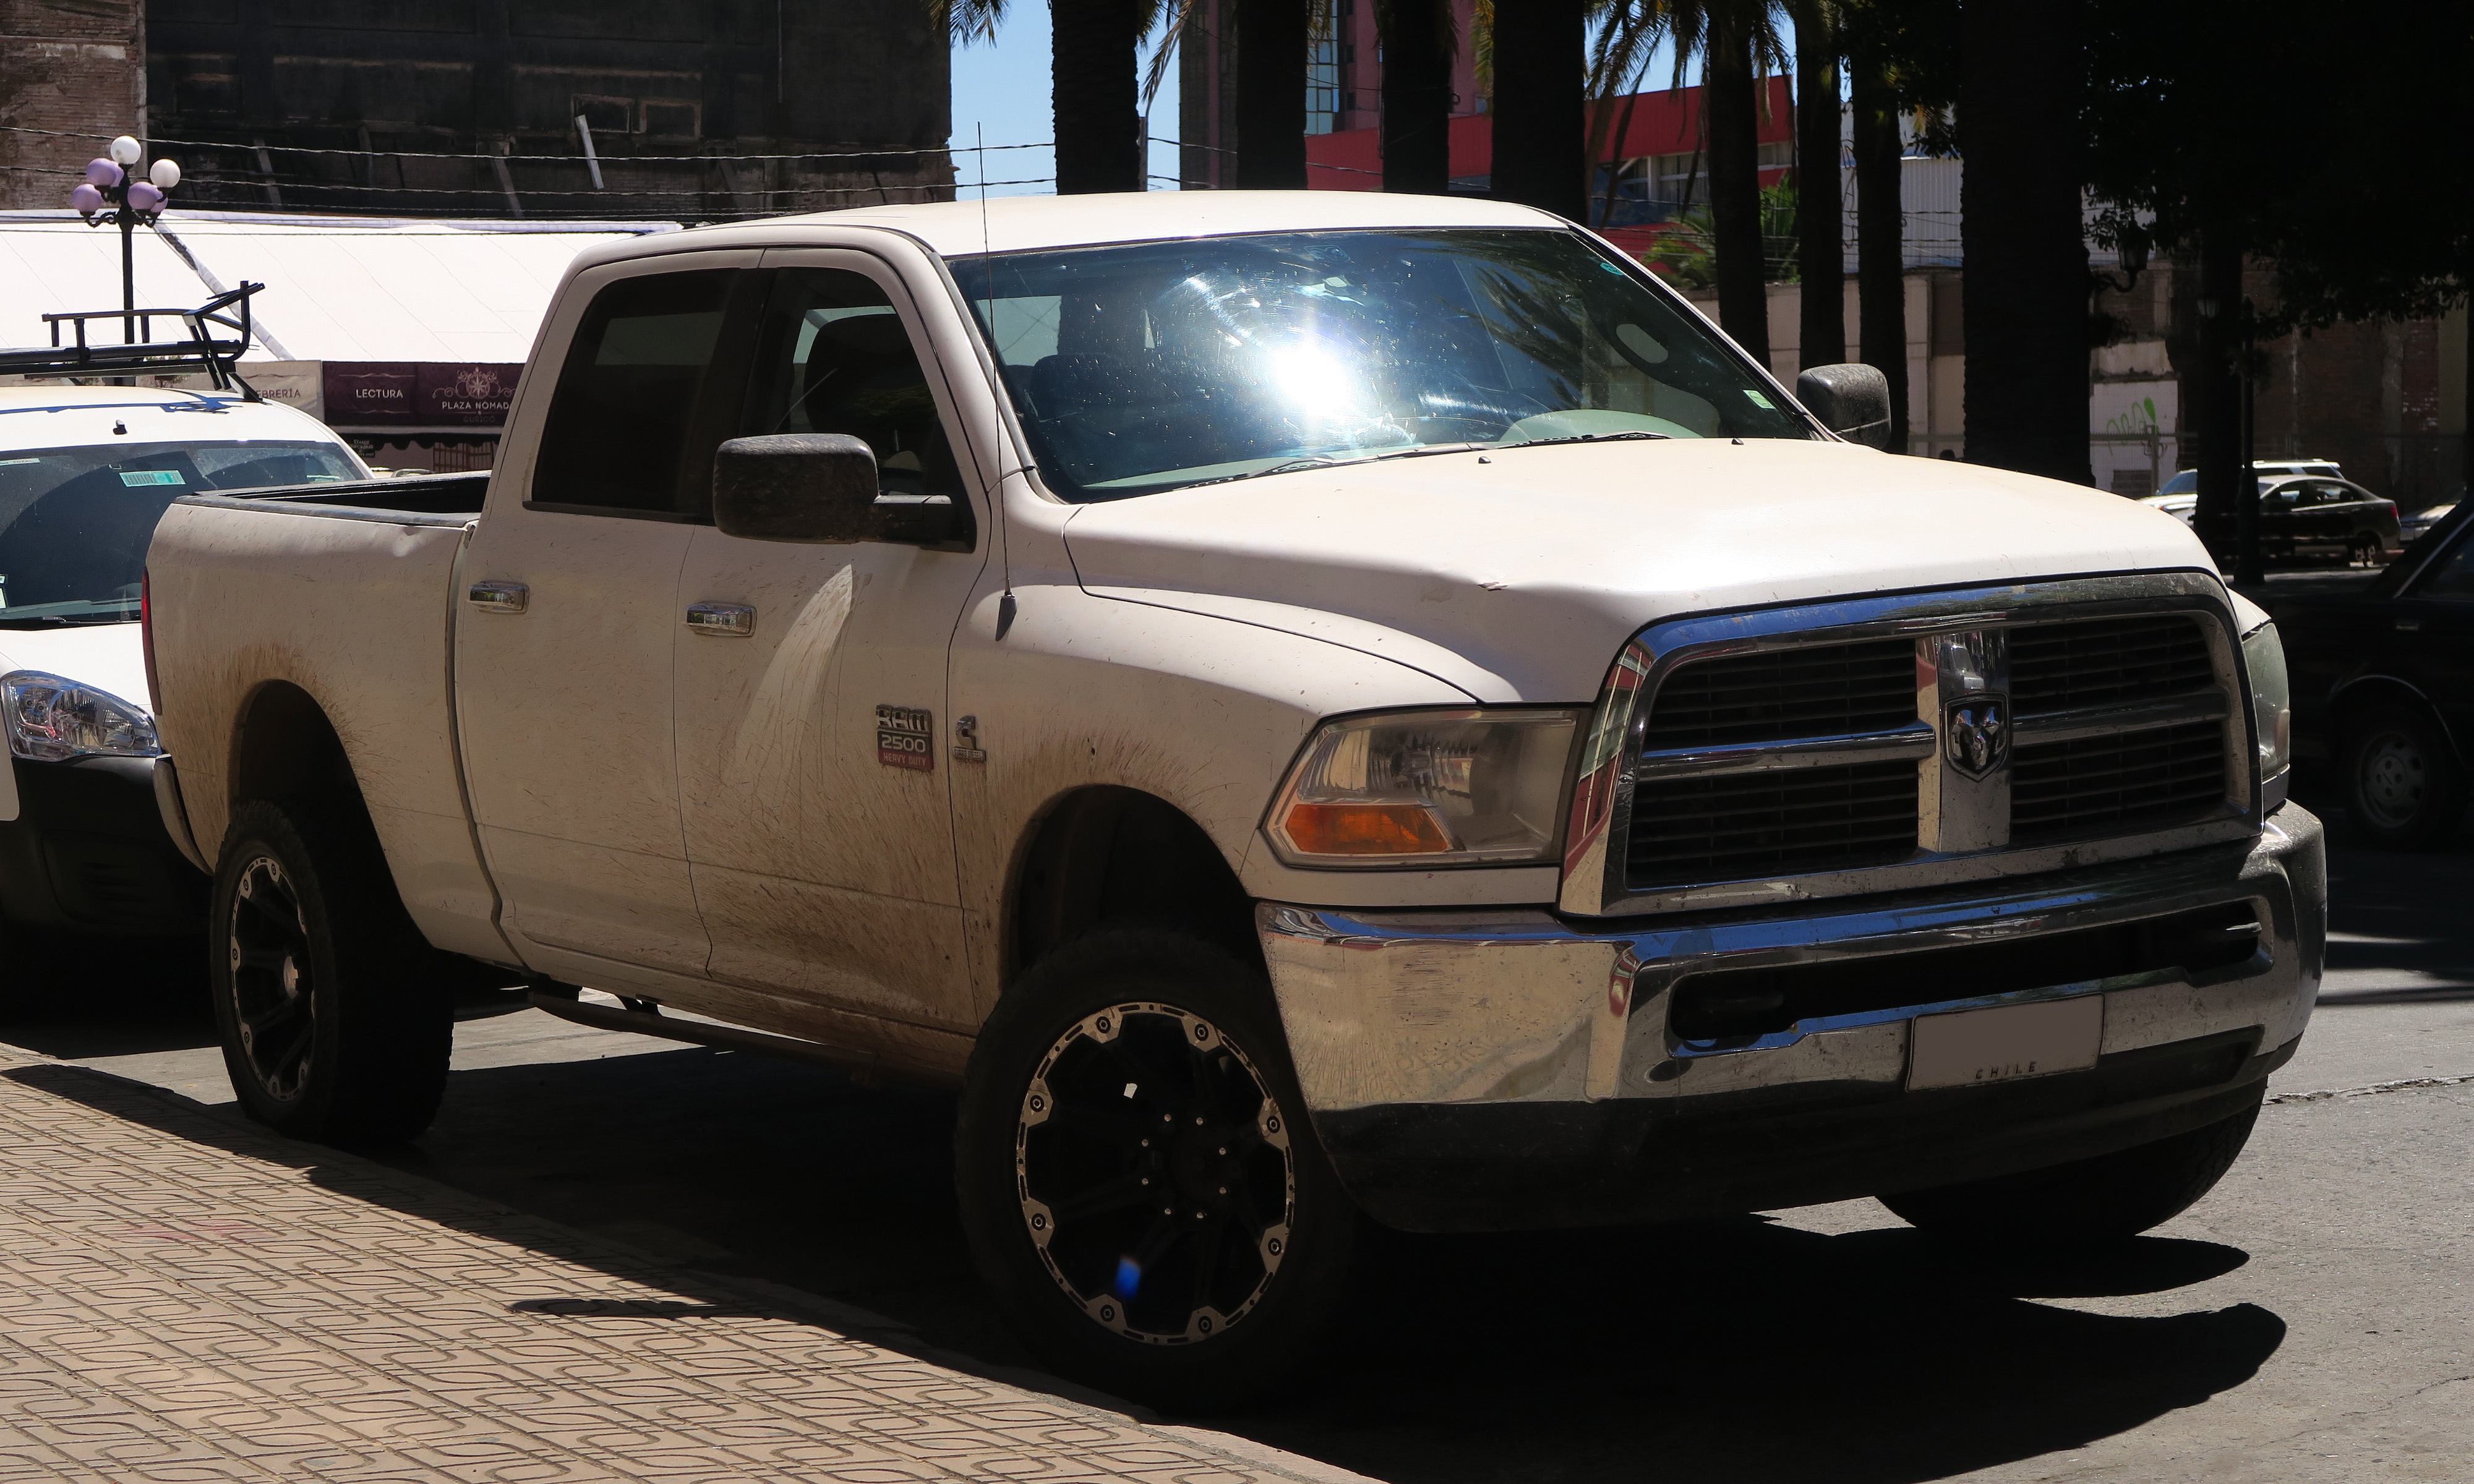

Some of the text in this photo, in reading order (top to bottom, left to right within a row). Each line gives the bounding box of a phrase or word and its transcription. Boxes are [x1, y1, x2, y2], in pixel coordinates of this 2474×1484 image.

[356, 388, 403, 399] LECTURA
[442, 400, 510, 410] PLAZA NÓMAD
[463, 415, 495, 423] CURICÓ
[876, 704, 931, 731] RAM
[881, 734, 927, 754] 2500
[883, 752, 927, 767] HEAVY DUTY
[1975, 1060, 2037, 1080] CHILE
